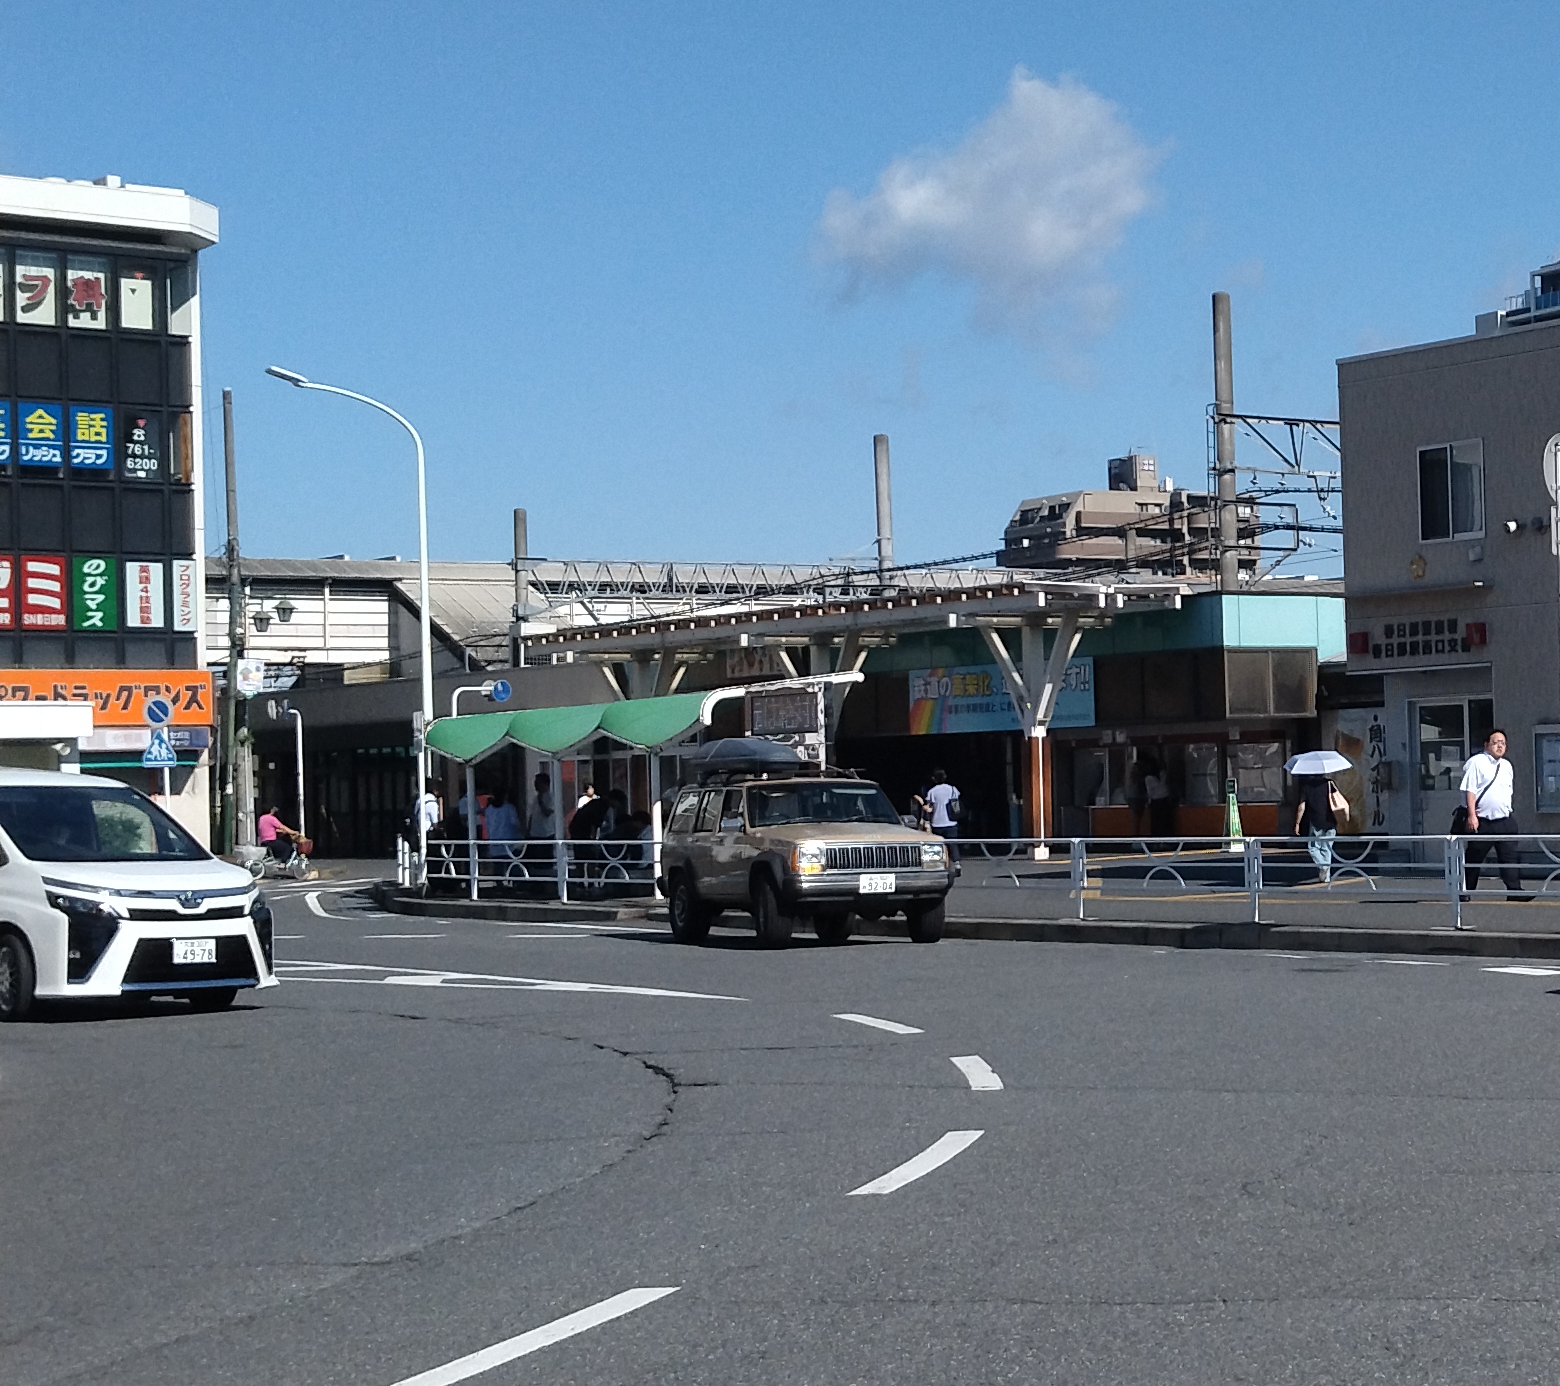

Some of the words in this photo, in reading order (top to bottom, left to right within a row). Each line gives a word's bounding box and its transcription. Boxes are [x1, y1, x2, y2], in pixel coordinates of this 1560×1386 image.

[0, 409, 107, 442] 会話
[126, 458, 158, 471] 6200
[81, 559, 108, 627] のびマス
[179, 564, 191, 626] プログラミング
[0, 683, 206, 711] ワードラッグンズ
